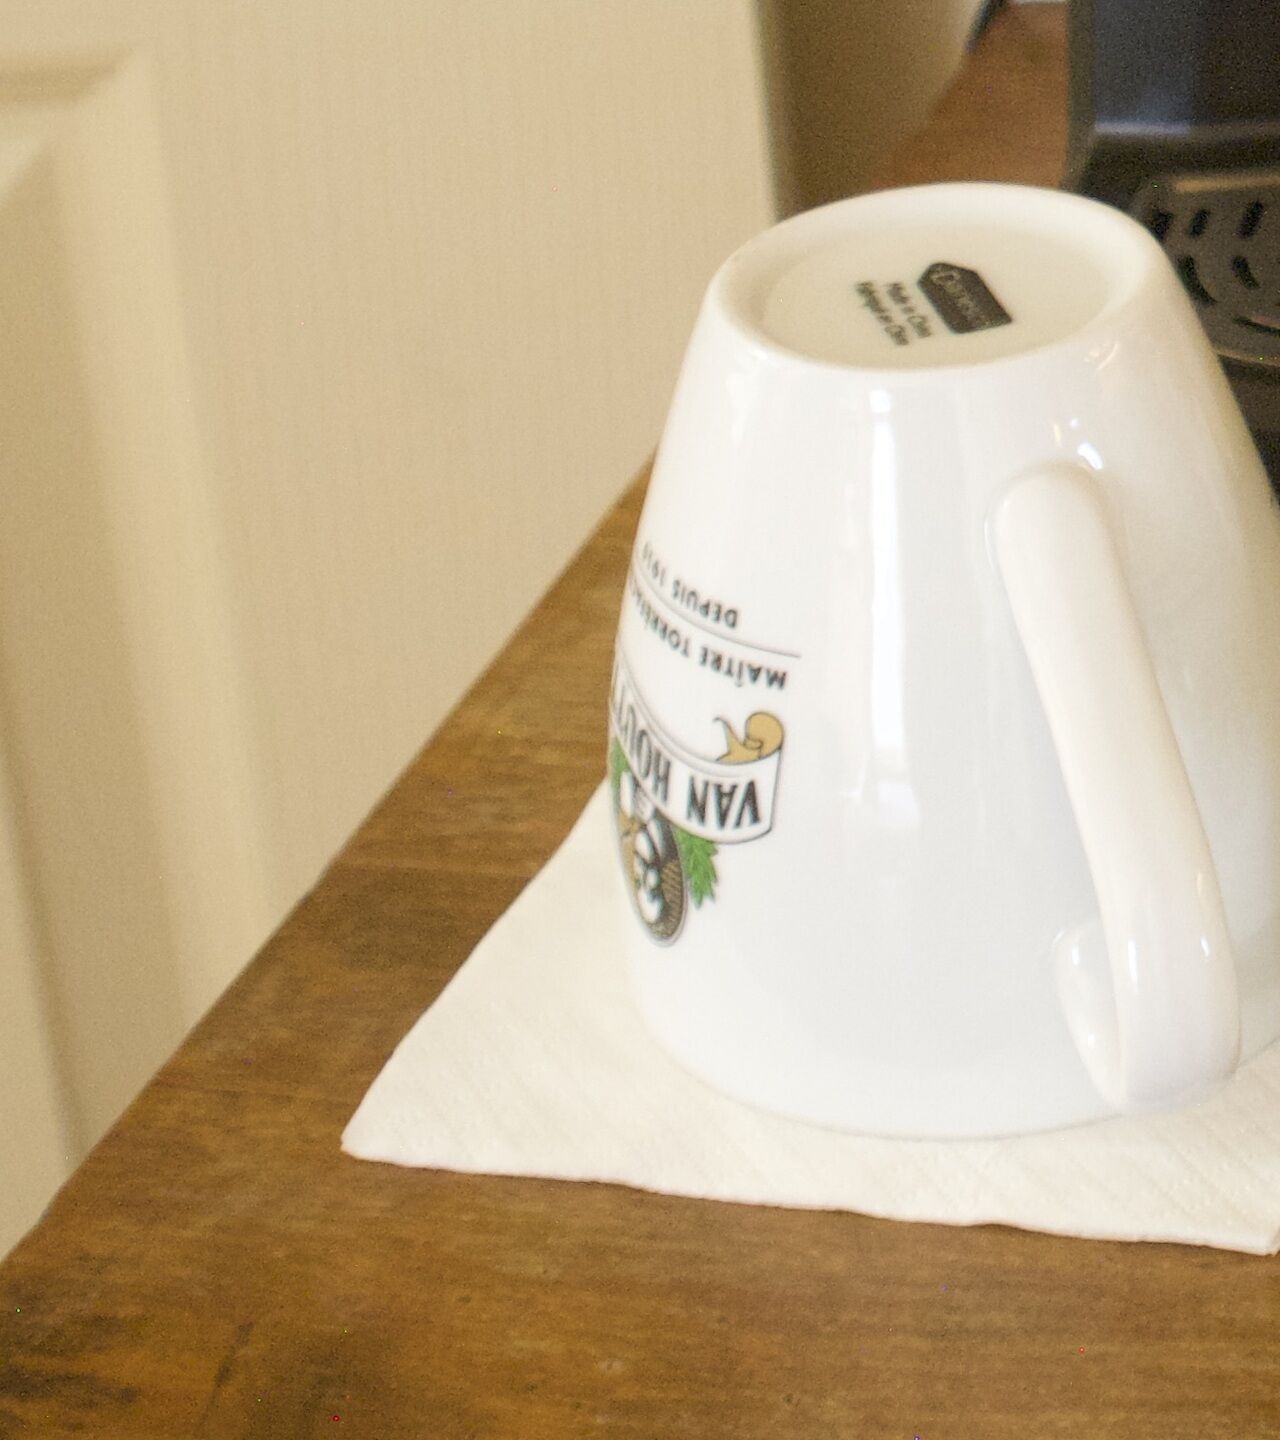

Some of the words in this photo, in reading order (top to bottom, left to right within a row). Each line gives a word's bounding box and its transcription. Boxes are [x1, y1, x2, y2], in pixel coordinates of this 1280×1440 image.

[671, 578, 738, 629] DEPUIS
[700, 646, 788, 690] MAÎTRE
[686, 775, 761, 830] VAN
